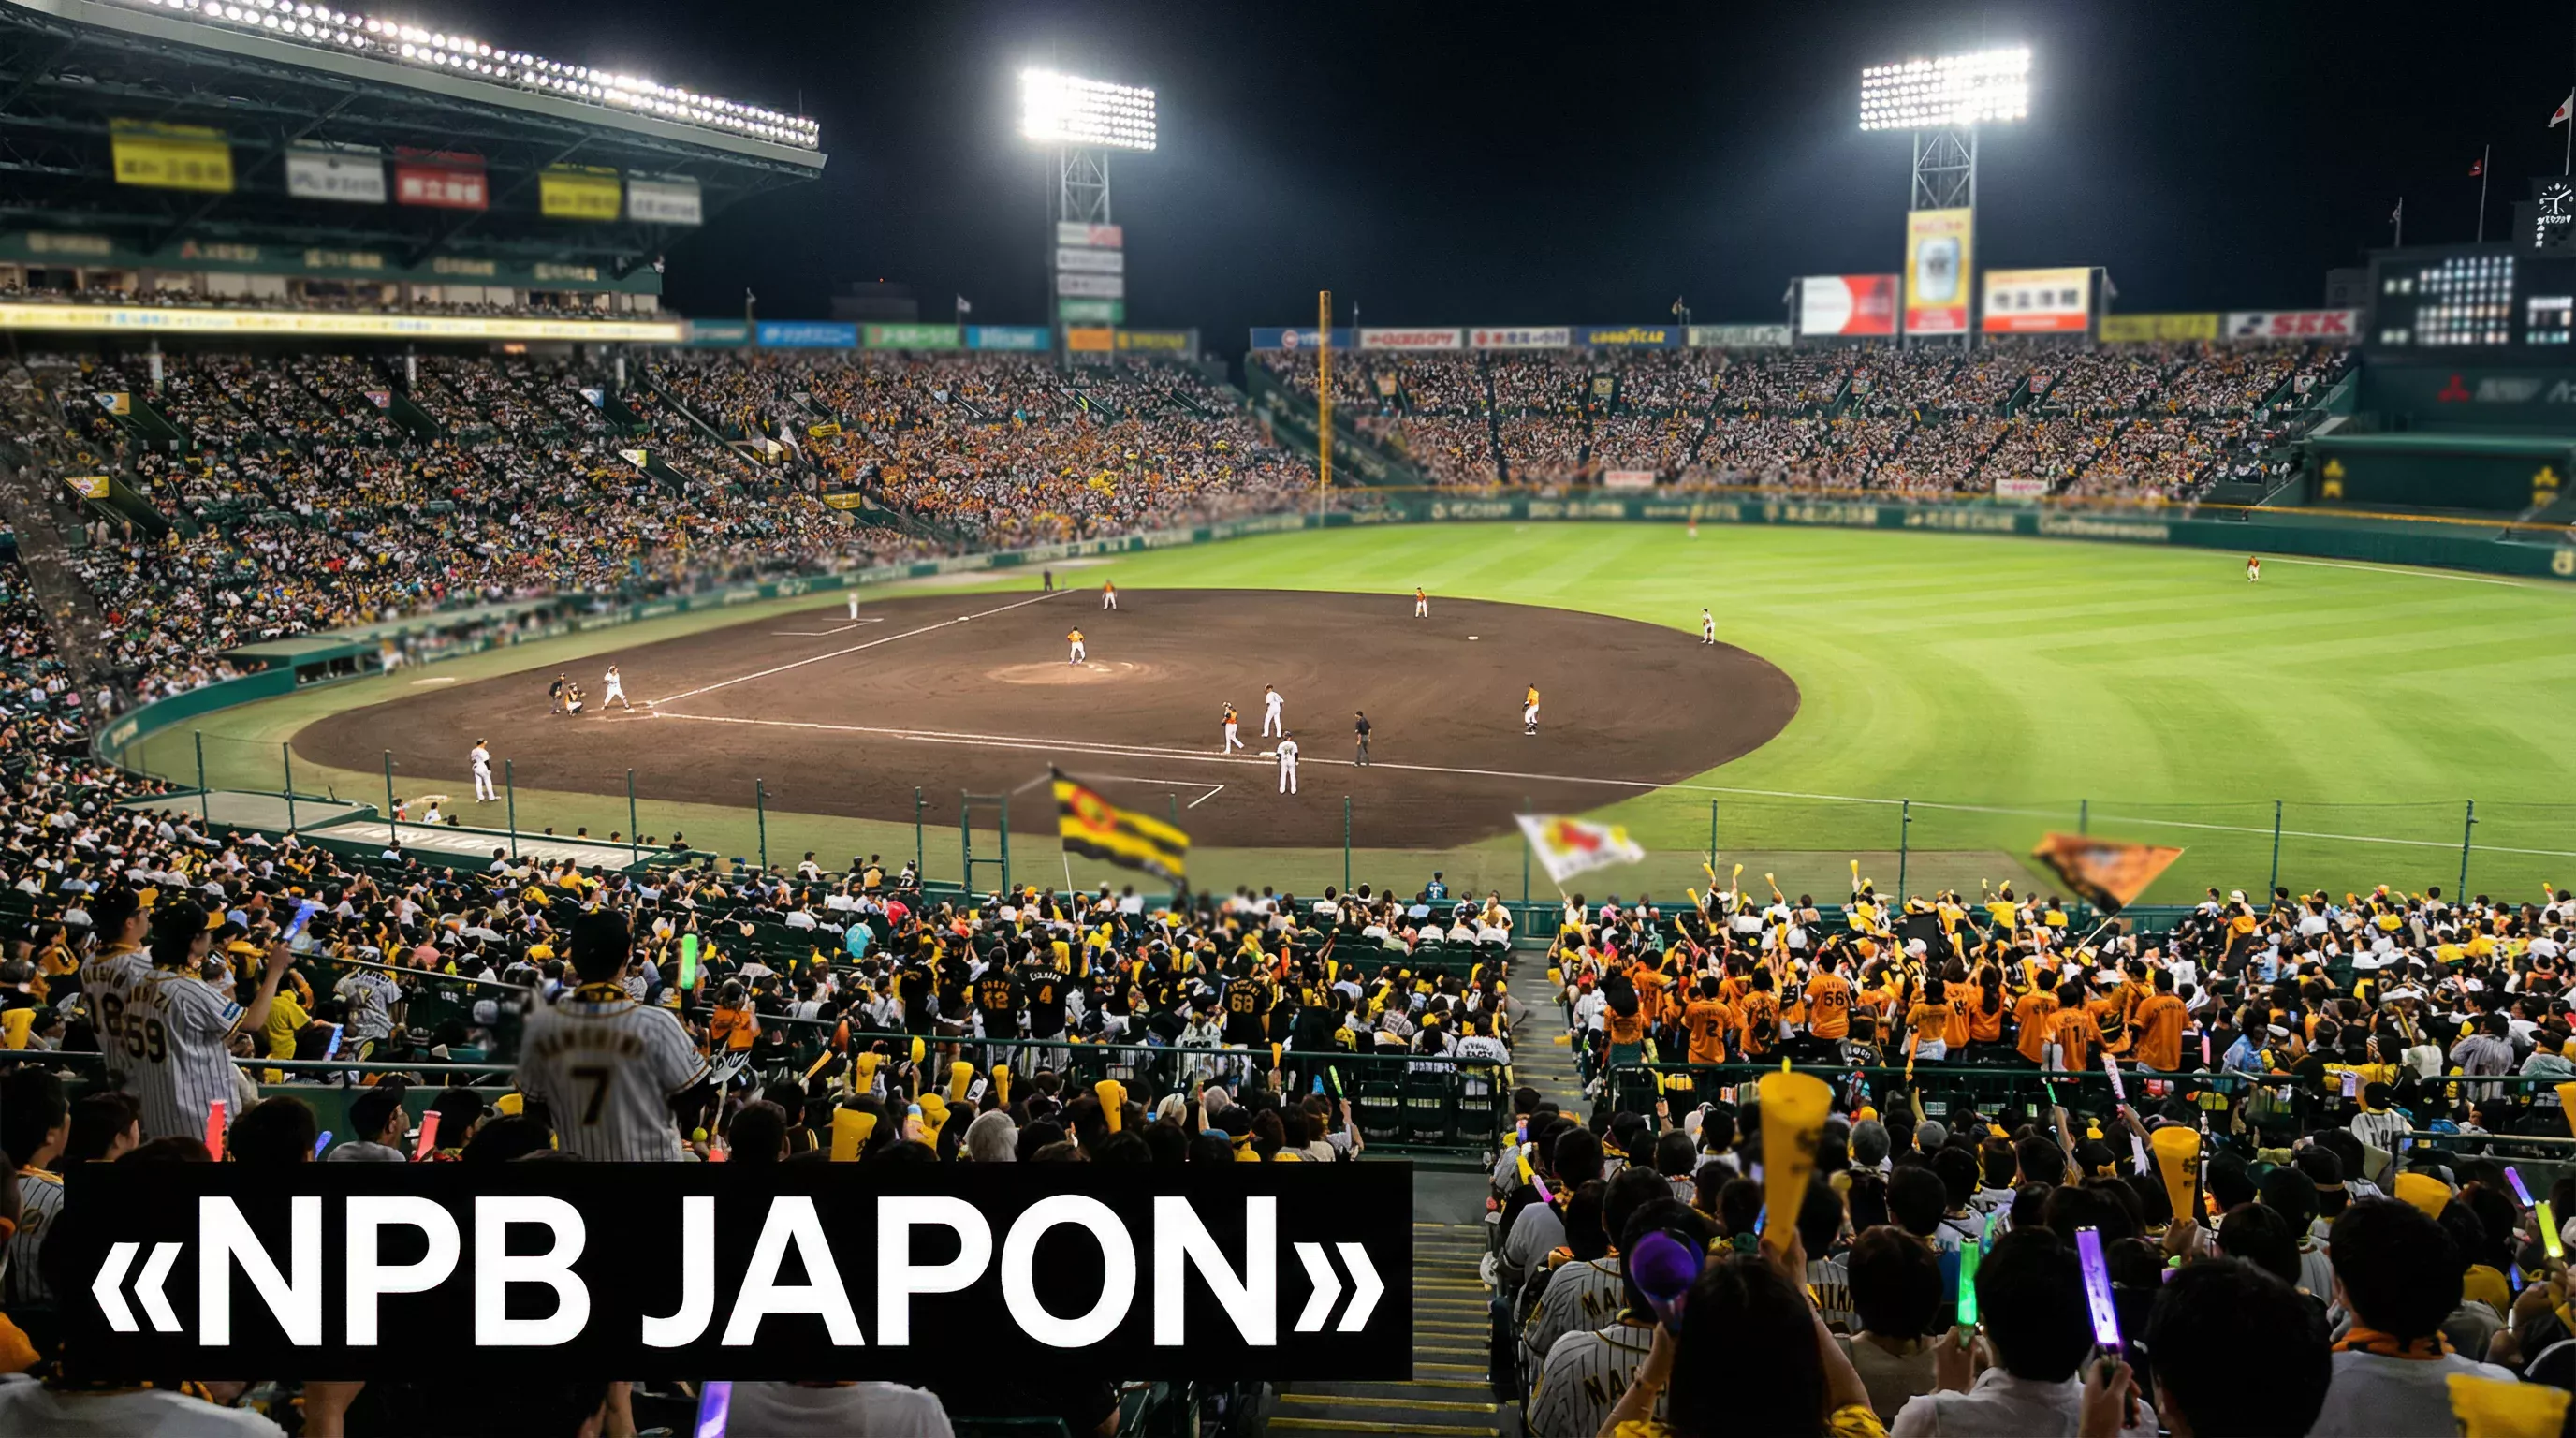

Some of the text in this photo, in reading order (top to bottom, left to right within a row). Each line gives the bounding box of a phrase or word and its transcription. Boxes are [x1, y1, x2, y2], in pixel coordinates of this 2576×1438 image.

[1039, 985, 1053, 1005] 4
[1231, 993, 1255, 1014] 68
[125, 1013, 167, 1064] 59
[571, 1065, 610, 1126] 7
